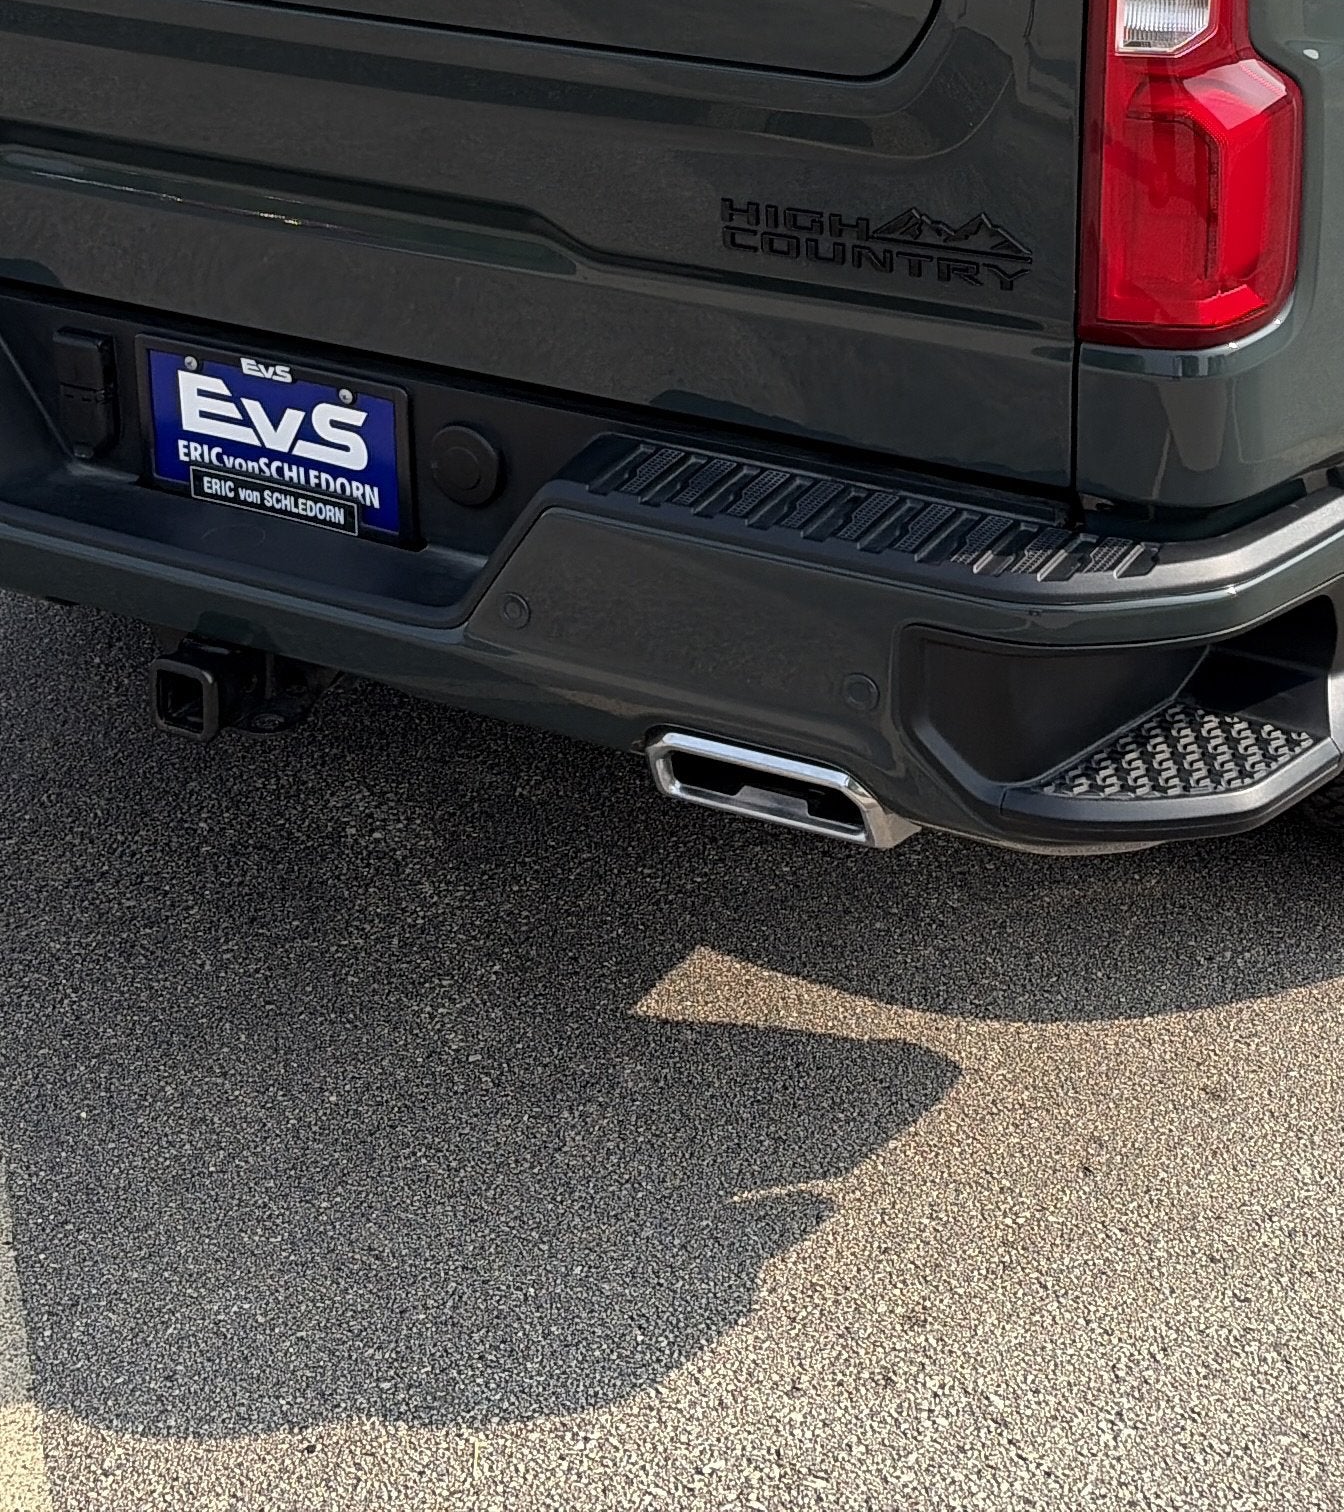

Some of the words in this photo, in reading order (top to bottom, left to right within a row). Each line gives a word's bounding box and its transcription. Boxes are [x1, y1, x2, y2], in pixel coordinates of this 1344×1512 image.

[720, 197, 870, 242] HIGH
[722, 226, 1032, 292] COUNTRY
[202, 476, 235, 498] ERIC
[237, 487, 261, 505] von
[263, 489, 345, 525] SCHLEDORN
